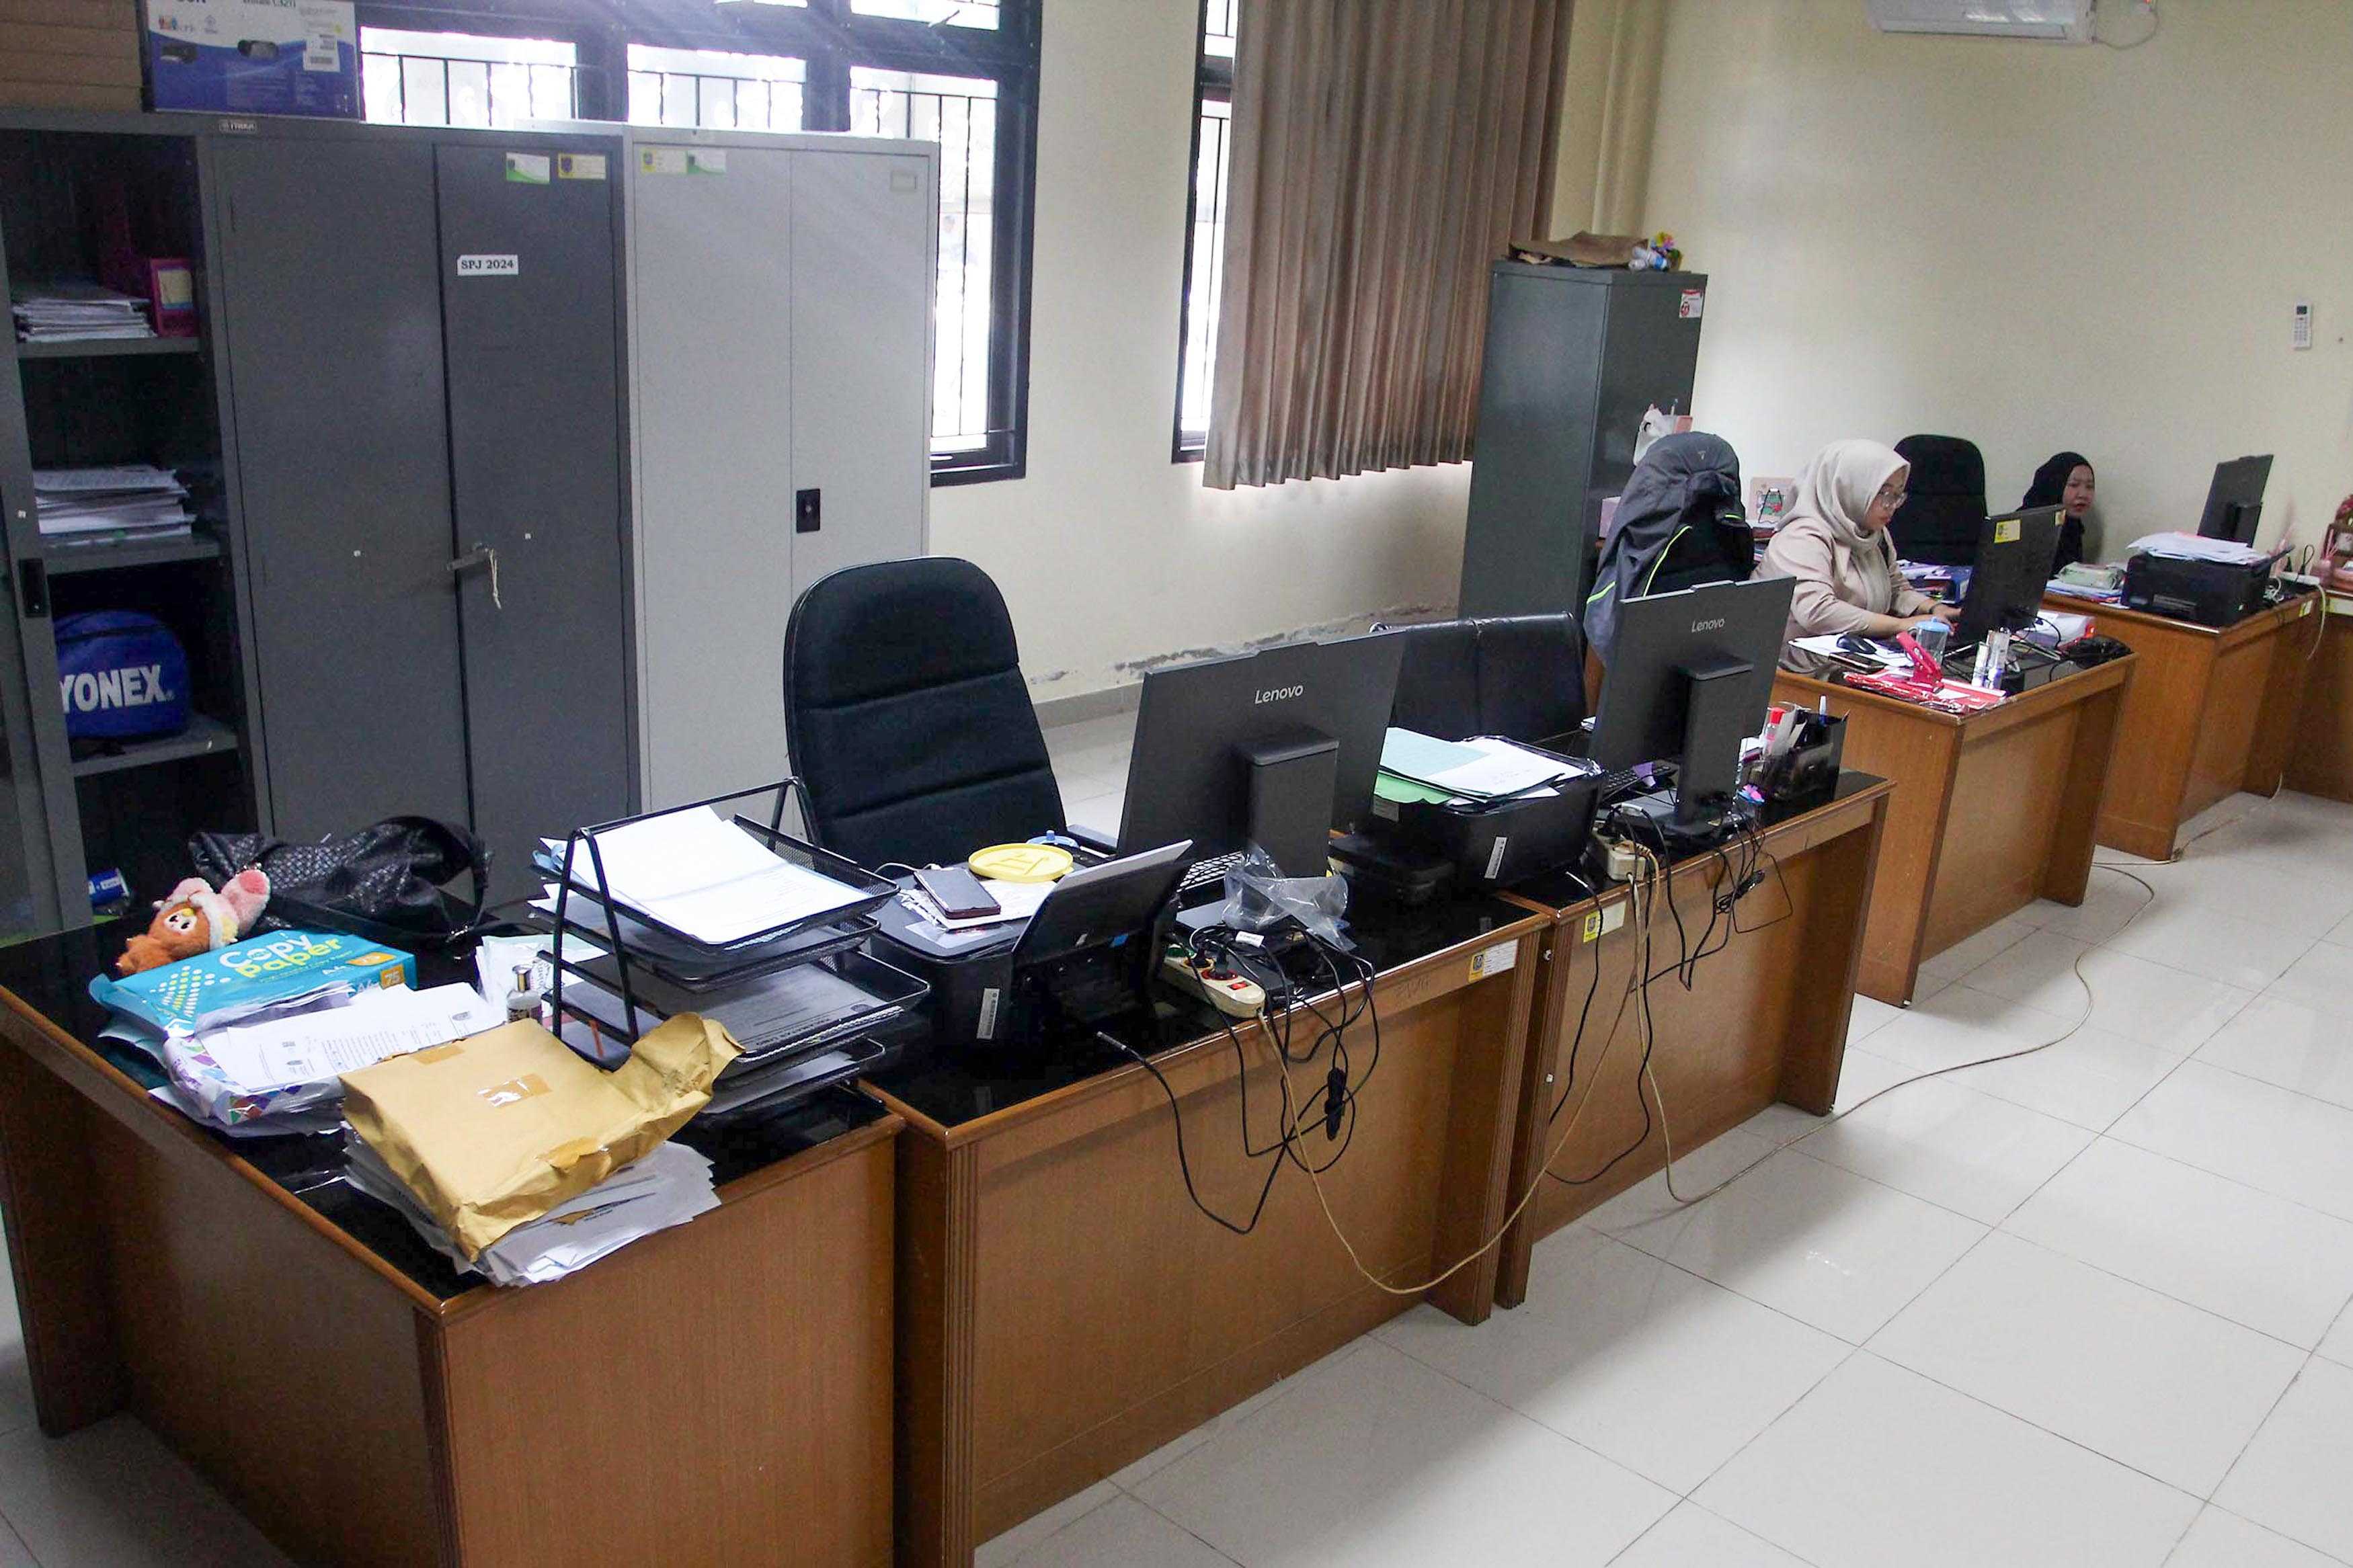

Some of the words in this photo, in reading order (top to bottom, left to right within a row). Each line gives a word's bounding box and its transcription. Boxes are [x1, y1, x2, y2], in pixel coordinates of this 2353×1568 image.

[461, 259, 482, 270] SPJ
[486, 259, 514, 269] 2024
[1691, 618, 1725, 632] Lenovo
[59, 665, 165, 714] YONEX
[1254, 685, 1304, 704] Lenovo
[219, 934, 313, 968] Copy
